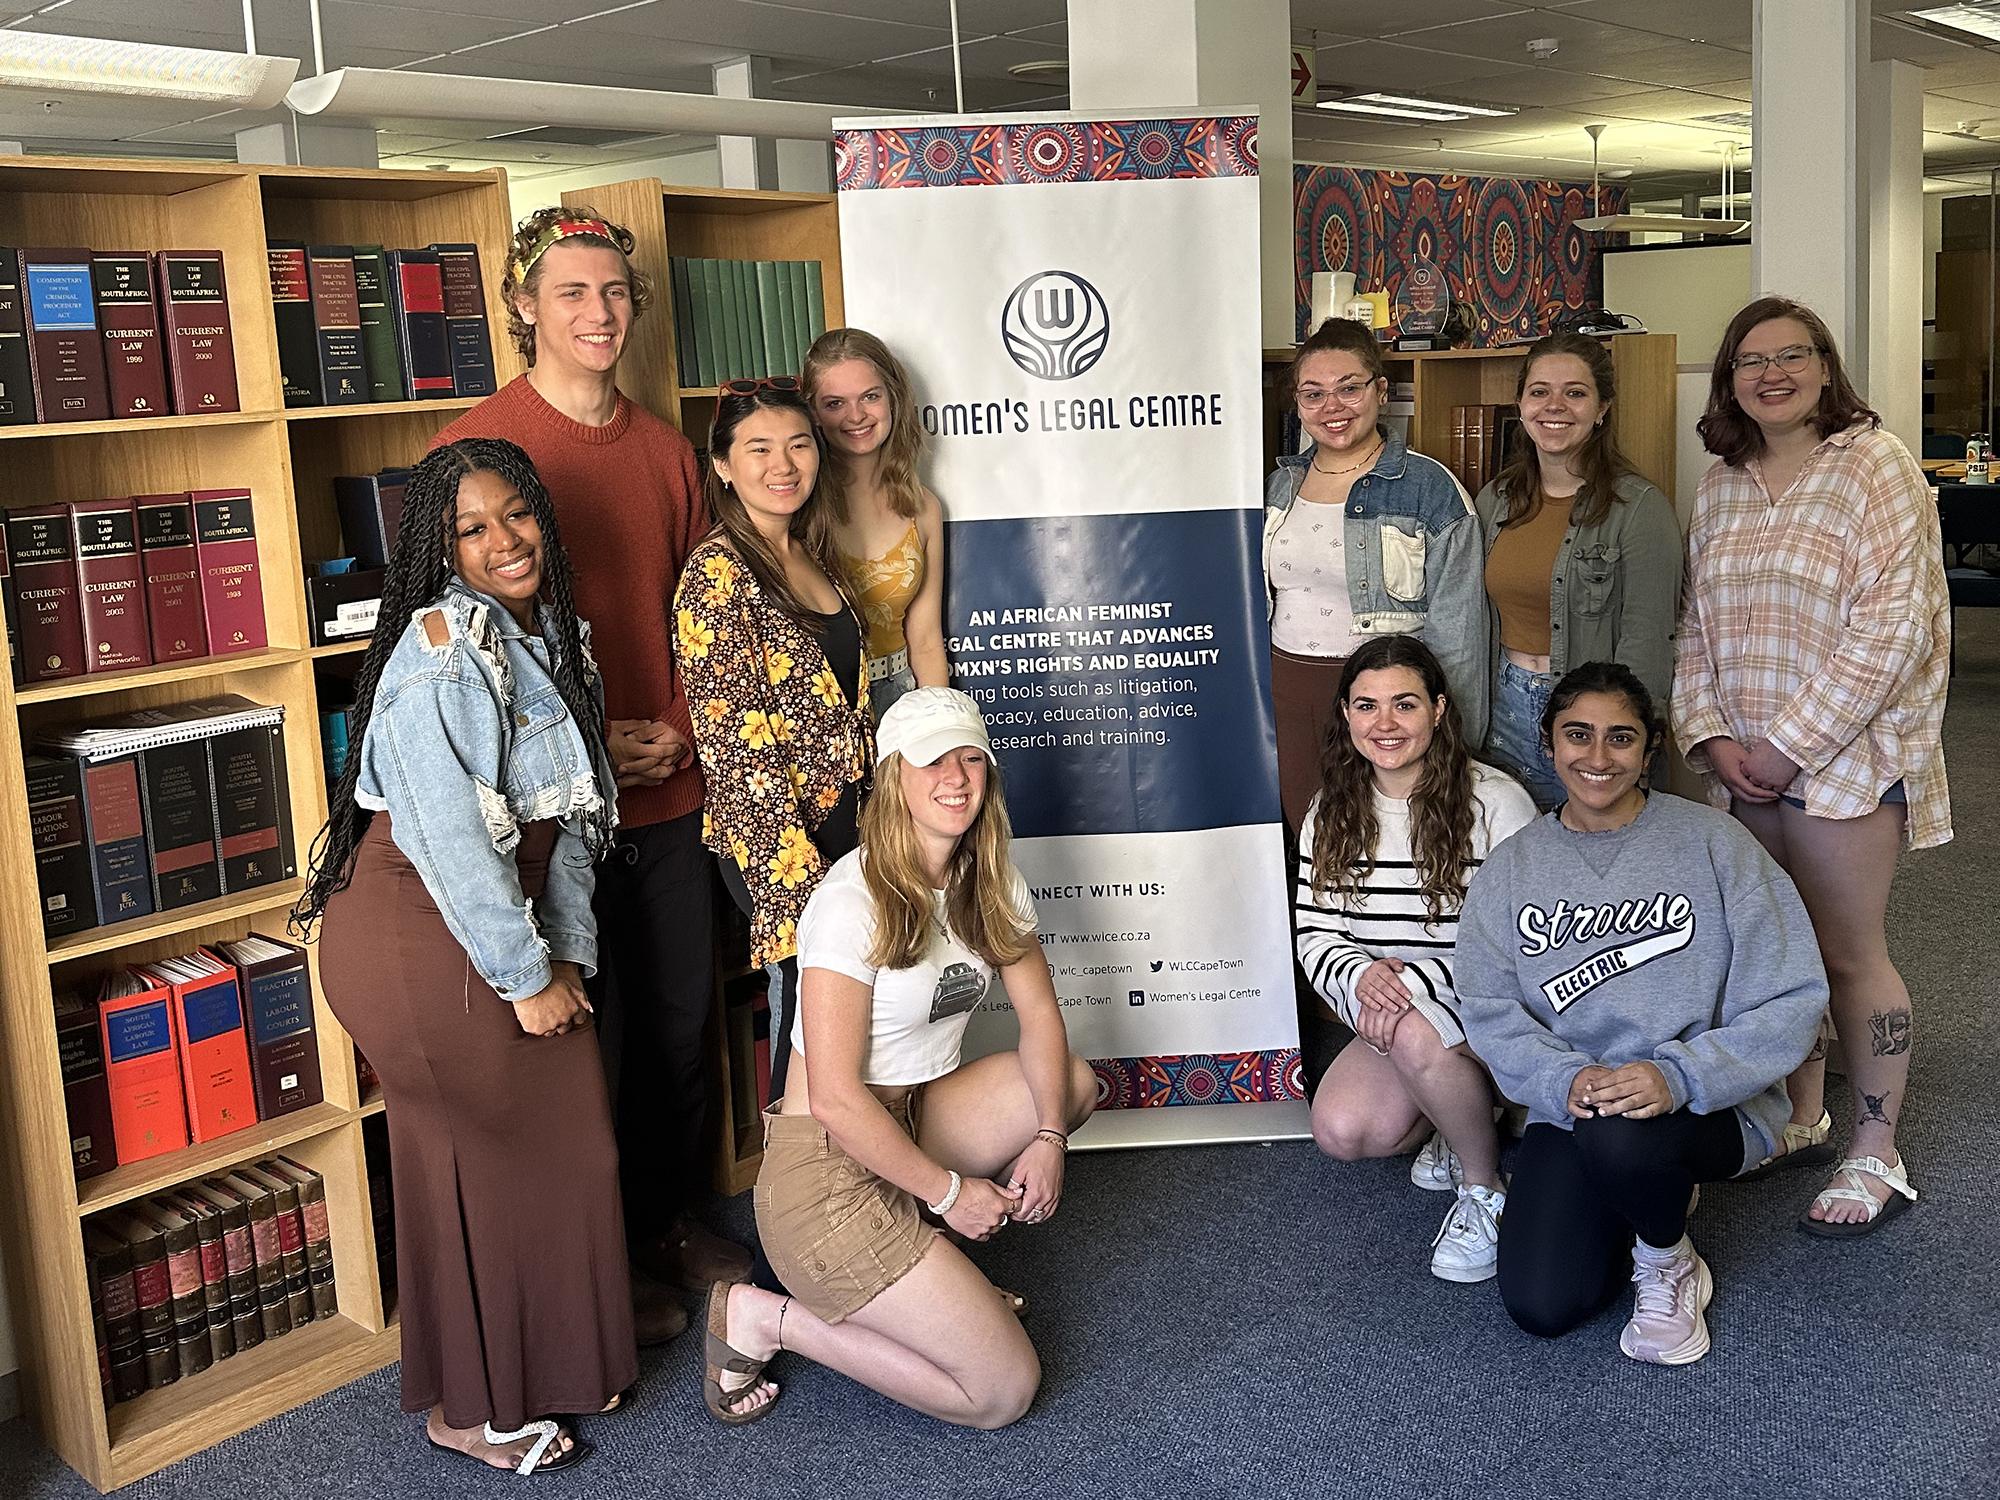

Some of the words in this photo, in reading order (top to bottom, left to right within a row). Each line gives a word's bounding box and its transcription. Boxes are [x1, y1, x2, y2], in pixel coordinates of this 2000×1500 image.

[196, 288, 219, 296] AFRICA
[1034, 288, 1075, 329] W
[106, 329, 154, 338] CURRENT
[176, 326, 224, 336] CURRENT
[122, 342, 142, 350] LAW
[192, 339, 212, 348] LAW
[914, 398, 1029, 436] OMEN'S
[1040, 396, 1120, 432] LEGAL
[1129, 393, 1222, 427] CENTRE
[34, 532, 48, 540] LAW
[17, 550, 41, 558] SOUTH
[42, 548, 66, 556] AFRICA
[81, 544, 106, 552] SOUTH
[106, 542, 132, 550] AFRICA
[208, 564, 254, 576] CURRENT
[148, 570, 196, 584] CURRENT
[222, 577, 242, 586] LAW
[84, 580, 137, 593] CURRENT
[164, 585, 184, 594] LAW
[20, 588, 71, 600] CURRENT
[102, 594, 124, 604] LAW
[37, 602, 59, 612] LAW
[106, 608, 124, 616] 2003
[969, 610, 996, 627] AN
[1001, 606, 1082, 625] AFRICAN
[1088, 602, 1172, 622] FEMINIST
[943, 636, 985, 652] GAL
[990, 632, 1062, 650] CENTRE
[1066, 630, 1114, 647] THAT
[1120, 624, 1214, 645] ADVANCES
[948, 658, 1012, 678] MXN'S
[1017, 656, 1084, 674] RIGHTS
[1089, 653, 1128, 671] AND
[1134, 649, 1220, 670] EQUALITY
[1002, 682, 1044, 700] tools
[1049, 680, 1088, 698] such
[1094, 682, 1113, 696] as
[1118, 677, 1198, 697] litigation,
[981, 710, 1037, 726] ocacy,
[1043, 704, 1133, 722] education,
[1138, 701, 1198, 720] advice,
[1062, 729, 1094, 746] and
[1100, 727, 1171, 748] training.
[33, 813, 63, 825] LABOUR
[34, 821, 70, 835] ELATIONS
[1030, 886, 1083, 900] NNECT
[1090, 884, 1133, 898] WITH
[1140, 882, 1166, 896] US:
[119, 902, 137, 912] JUTA
[1518, 892, 1694, 957] Strouse
[1038, 934, 1056, 944] SIT
[1059, 963, 1133, 978] wlc_capetown
[1168, 959, 1244, 972] WLCCapeTown
[1554, 950, 1628, 1002] ELECTRIC
[260, 976, 299, 993] PRACTICE
[990, 1001, 1014, 1012] Lega
[1057, 997, 1082, 1008] Cape
[1085, 996, 1112, 1006] Town
[1149, 992, 1196, 1002] Women's
[1199, 990, 1226, 1002] Legal
[1229, 988, 1261, 1000] Centre
[265, 1002, 299, 1017] LABOUR
[266, 1016, 300, 1030] COURTS
